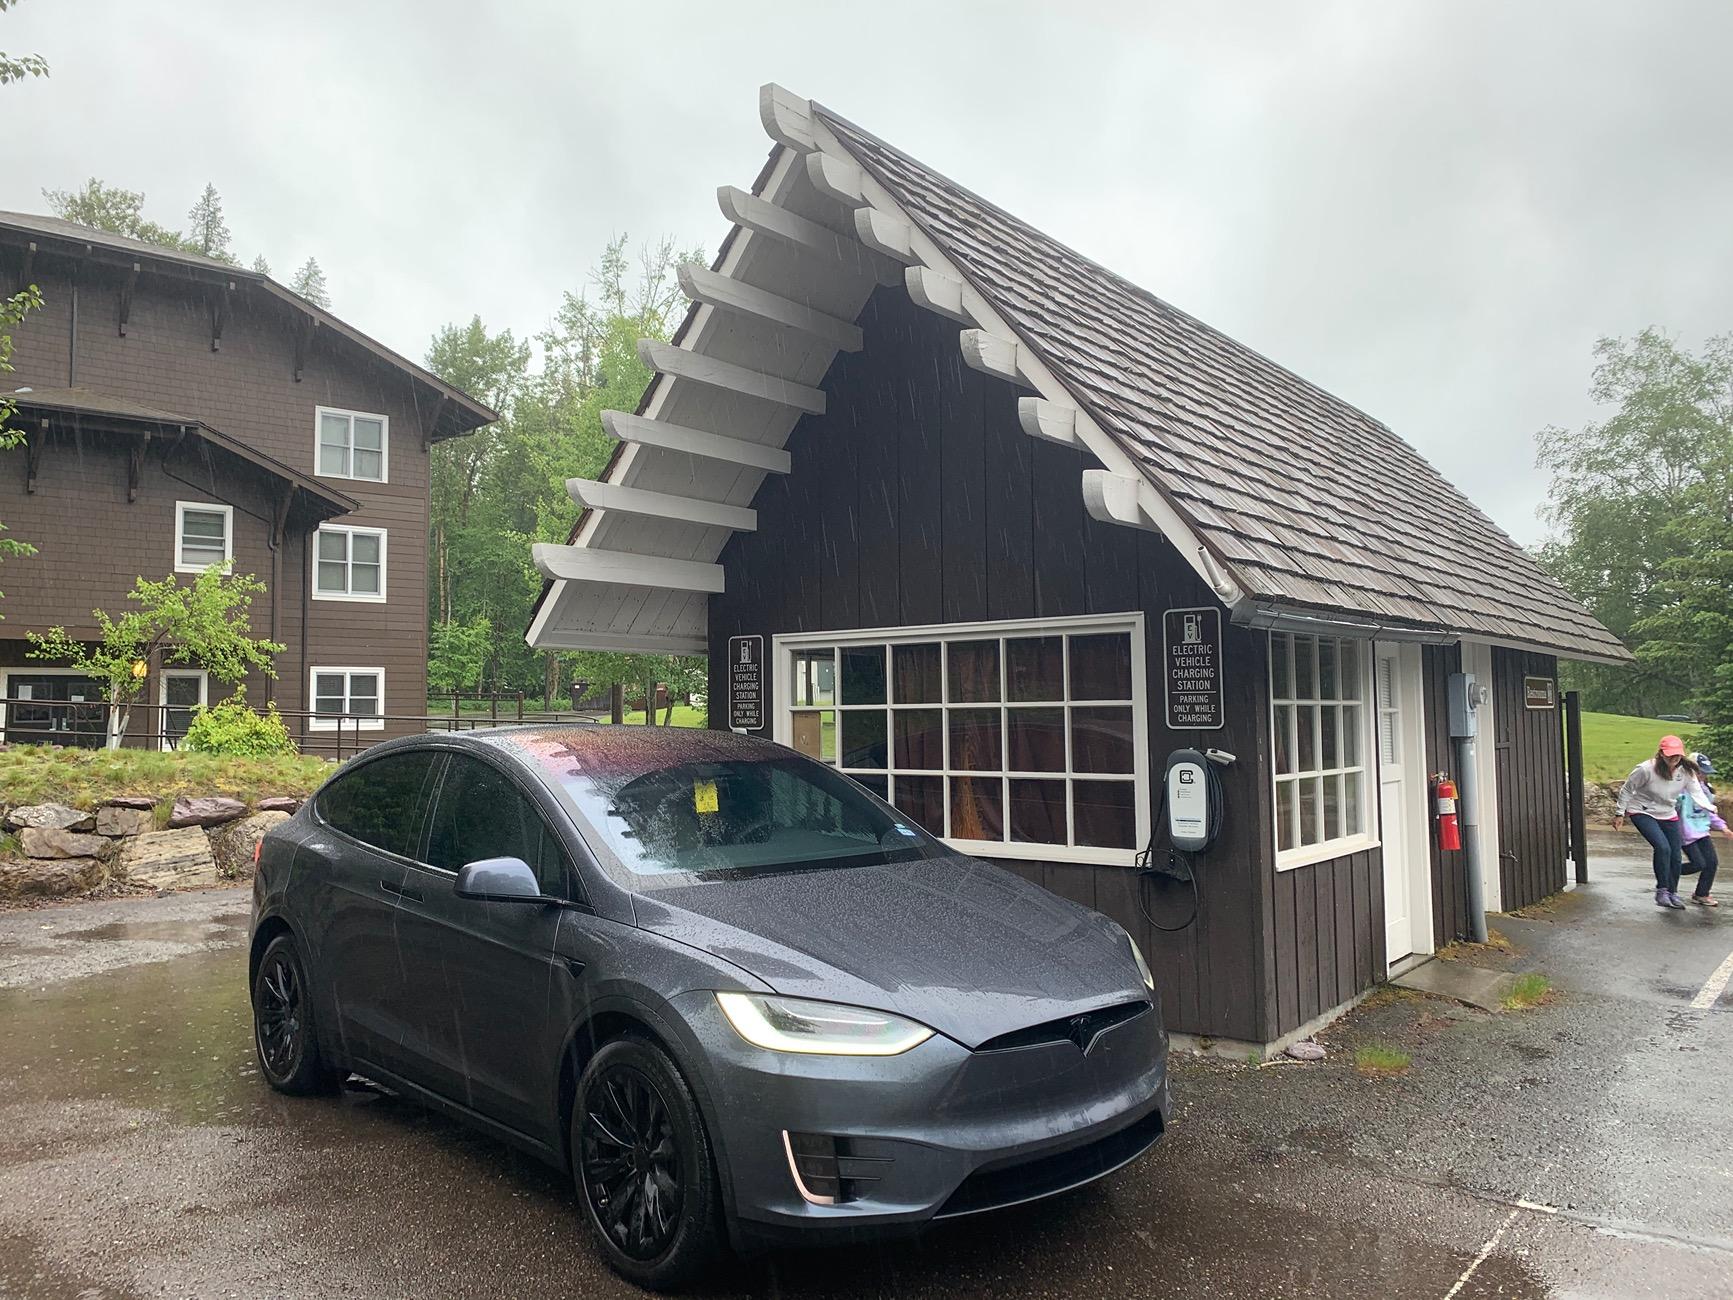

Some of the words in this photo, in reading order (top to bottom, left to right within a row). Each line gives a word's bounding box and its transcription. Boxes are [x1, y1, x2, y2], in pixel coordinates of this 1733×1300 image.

[1172, 644, 1213, 655] ELECTRIC
[1175, 657, 1211, 666] VEHICLE
[734, 664, 758, 672] ELECTRIC
[735, 673, 757, 681] VEHICLE
[1172, 669, 1214, 679] CHARGING
[734, 682, 759, 691] CHARGING
[1177, 680, 1210, 690] STATION
[1180, 695, 1209, 703] PARKING
[1178, 714, 1212, 722] CHARGING
